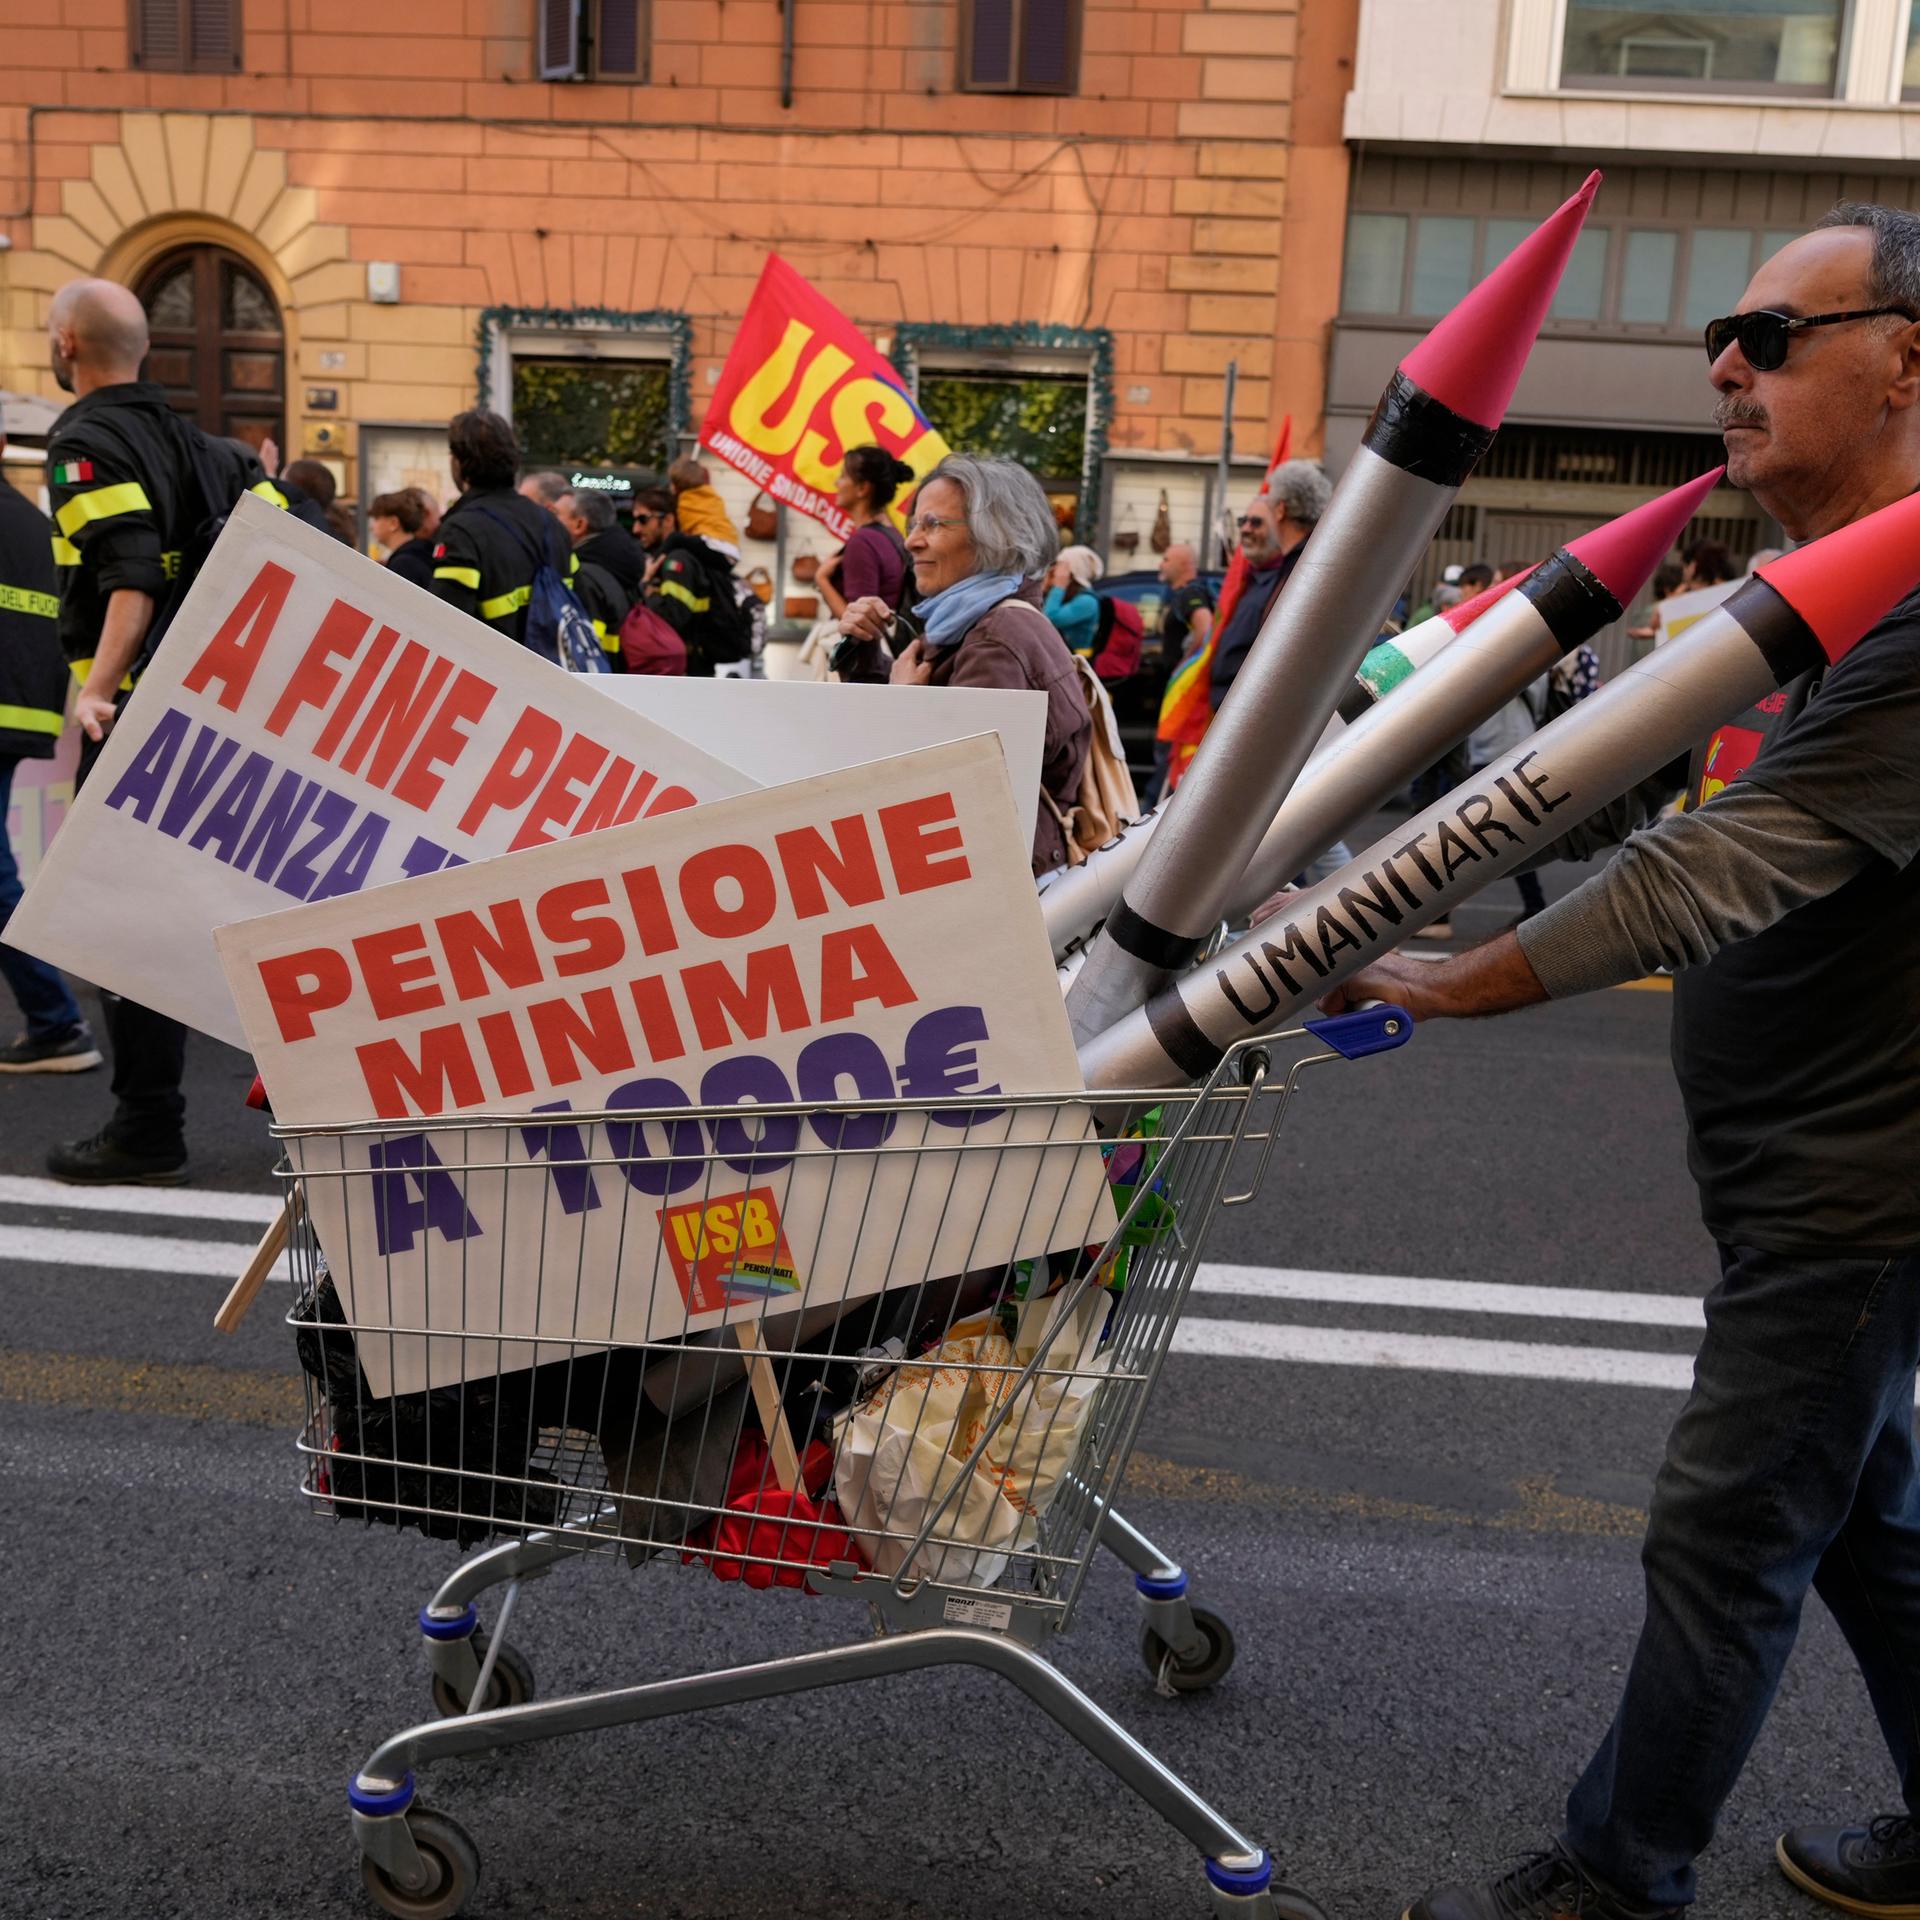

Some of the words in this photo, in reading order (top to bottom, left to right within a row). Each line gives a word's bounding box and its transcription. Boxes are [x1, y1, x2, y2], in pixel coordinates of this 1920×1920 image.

[708, 431, 775, 486] UNIONE
[104, 707, 391, 903] AVANZA
[182, 560, 296, 713] A
[264, 598, 498, 812] FINE
[457, 705, 698, 853] PEN
[258, 792, 972, 1044] PENSIONE
[1216, 750, 1572, 1026] UMANITARIE
[355, 923, 919, 1120] MINIMA
[368, 1133, 484, 1257] A
[520, 1005, 1007, 1215] 1000€
[671, 1198, 776, 1261] USB
